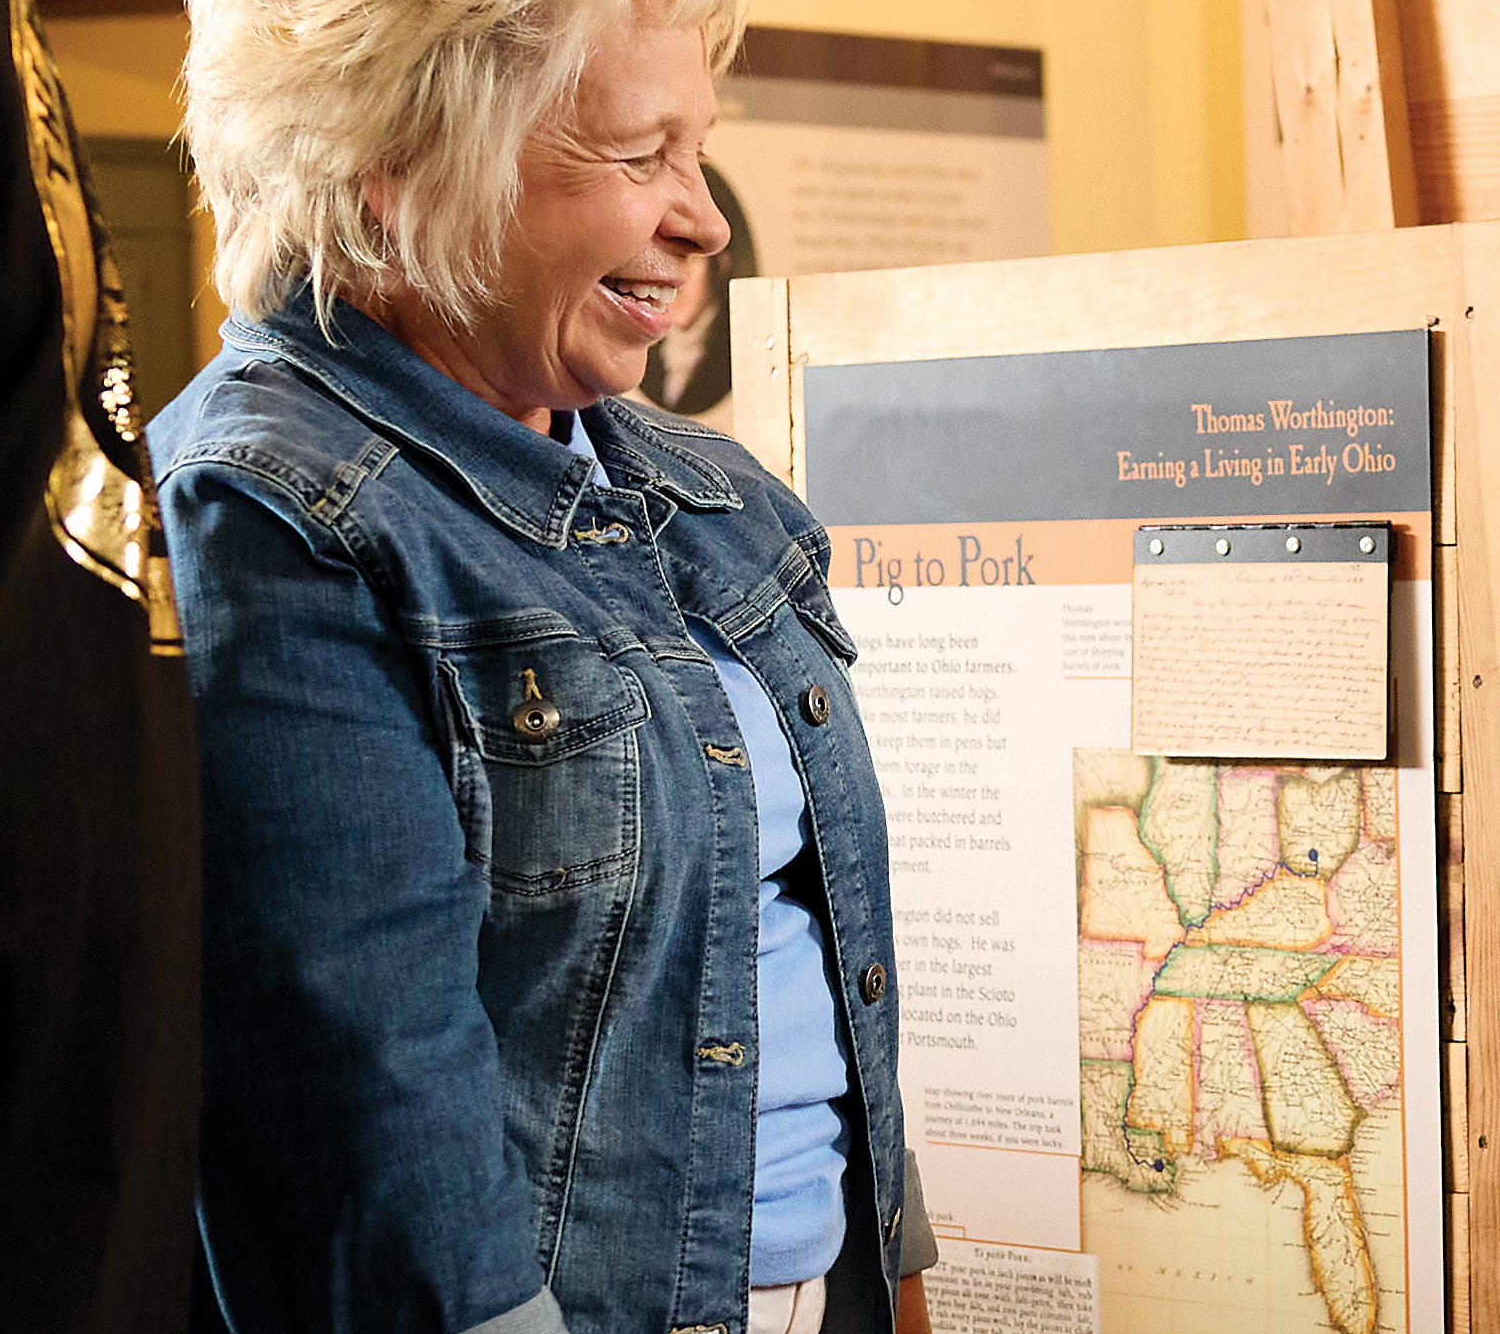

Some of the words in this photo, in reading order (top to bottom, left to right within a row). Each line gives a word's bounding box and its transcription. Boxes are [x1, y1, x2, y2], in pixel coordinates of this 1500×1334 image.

[1191, 403, 1265, 434] Thomas
[1268, 400, 1394, 437] Worthington:
[1117, 451, 1186, 488] Earning
[1190, 459, 1199, 478] a
[1204, 449, 1263, 485] Living
[1267, 448, 1284, 475] in
[1289, 444, 1337, 485] Early
[1342, 443, 1396, 473] Ohio
[853, 537, 904, 605] Pig
[914, 552, 945, 586] to
[958, 534, 1036, 587] Pork
[886, 632, 915, 648] have
[919, 632, 946, 653] long
[949, 632, 979, 649] been
[853, 660, 912, 678] important
[916, 660, 928, 674] to
[932, 659, 962, 675] Ohio
[965, 658, 1016, 674] farmers.
[930, 683, 965, 699] raised
[968, 683, 1000, 703] hogs.
[880, 710, 908, 724] most
[964, 708, 977, 724] he
[982, 708, 1001, 725] did
[877, 733, 903, 752] keep
[907, 733, 937, 749] them
[940, 734, 952, 749] in
[955, 736, 983, 755] pens
[986, 733, 1007, 750] but
[876, 756, 900, 773] hem
[904, 759, 940, 777] forage
[944, 759, 955, 774] in
[959, 758, 979, 775] the
[902, 785, 913, 798] In
[917, 783, 936, 799] the
[940, 785, 977, 800] winter
[981, 784, 1000, 800] the
[917, 807, 976, 825] butchered
[979, 809, 1002, 825] and
[910, 833, 951, 852] packed
[955, 835, 966, 850] in
[970, 834, 1012, 851] barrels
[933, 908, 952, 924] did
[956, 911, 976, 925] not
[979, 909, 1000, 926] sell
[903, 934, 929, 947] own
[932, 932, 963, 953] hogs.
[971, 935, 987, 951] He
[991, 938, 1016, 952] was
[915, 957, 927, 972] in
[930, 957, 949, 974] the
[952, 958, 993, 980] largest
[908, 980, 938, 1001] plant
[941, 983, 953, 998] in
[956, 983, 975, 1000] the
[978, 984, 1016, 1003] Scioto
[901, 1005, 943, 1023] located
[947, 1011, 962, 1025] on
[965, 1008, 985, 1026] the
[988, 1010, 1018, 1028] Ohio
[907, 1030, 979, 1051] Portsmouth.
